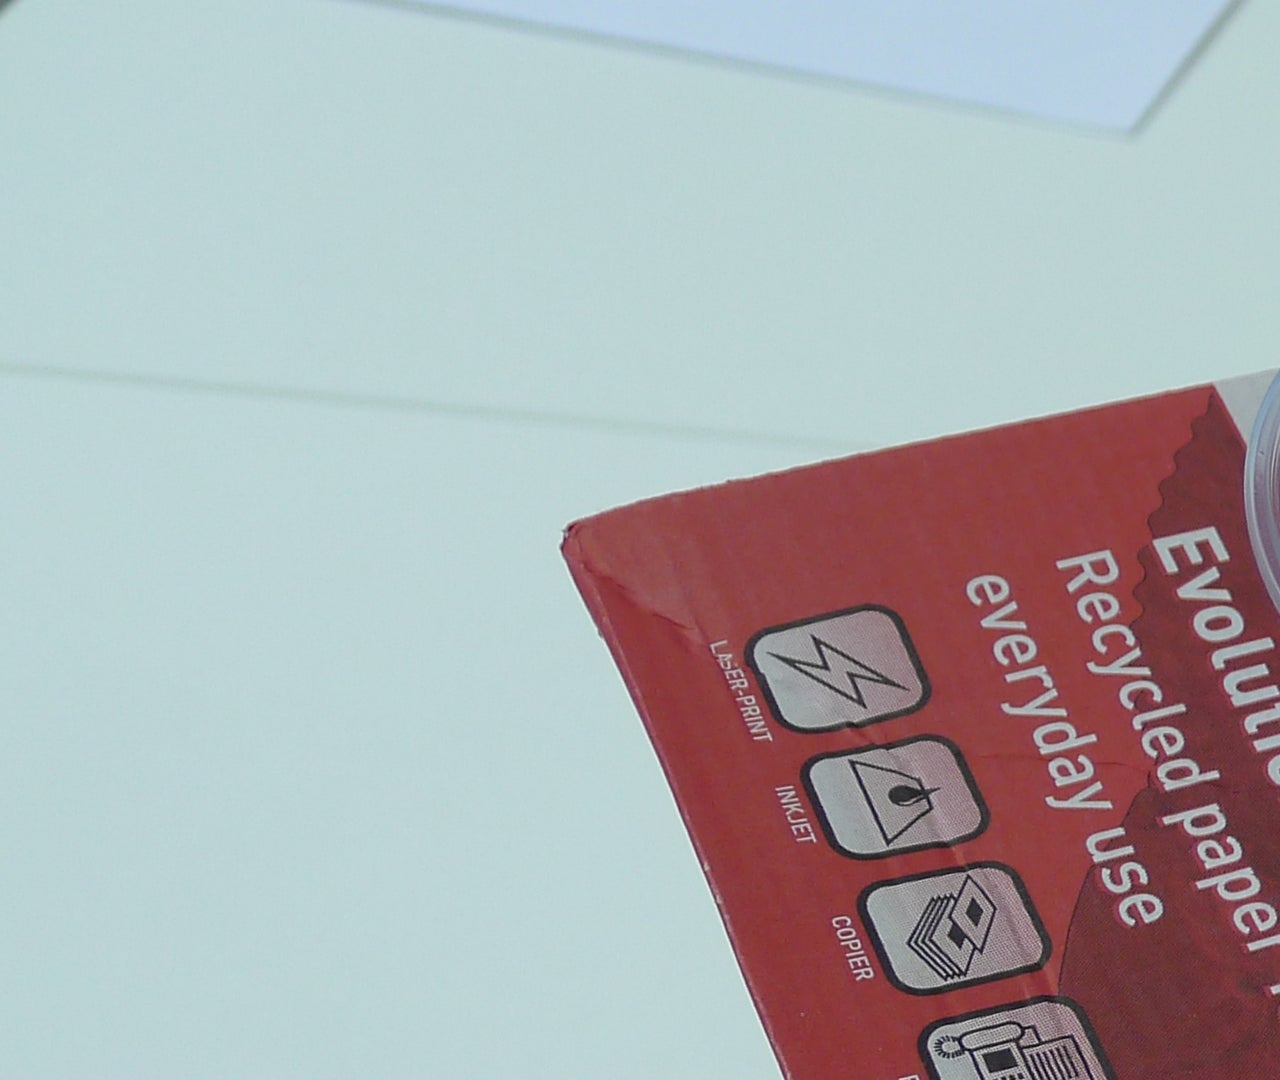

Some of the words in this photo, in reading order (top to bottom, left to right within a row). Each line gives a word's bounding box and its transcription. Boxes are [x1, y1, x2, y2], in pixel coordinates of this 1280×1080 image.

[710, 641, 773, 744] LASER-PRINT
[1055, 549, 1220, 793] Recycled
[965, 574, 1114, 816] everyday
[1085, 826, 1164, 927] use
[774, 785, 818, 845] INKJET
[832, 914, 874, 982] COPIER
